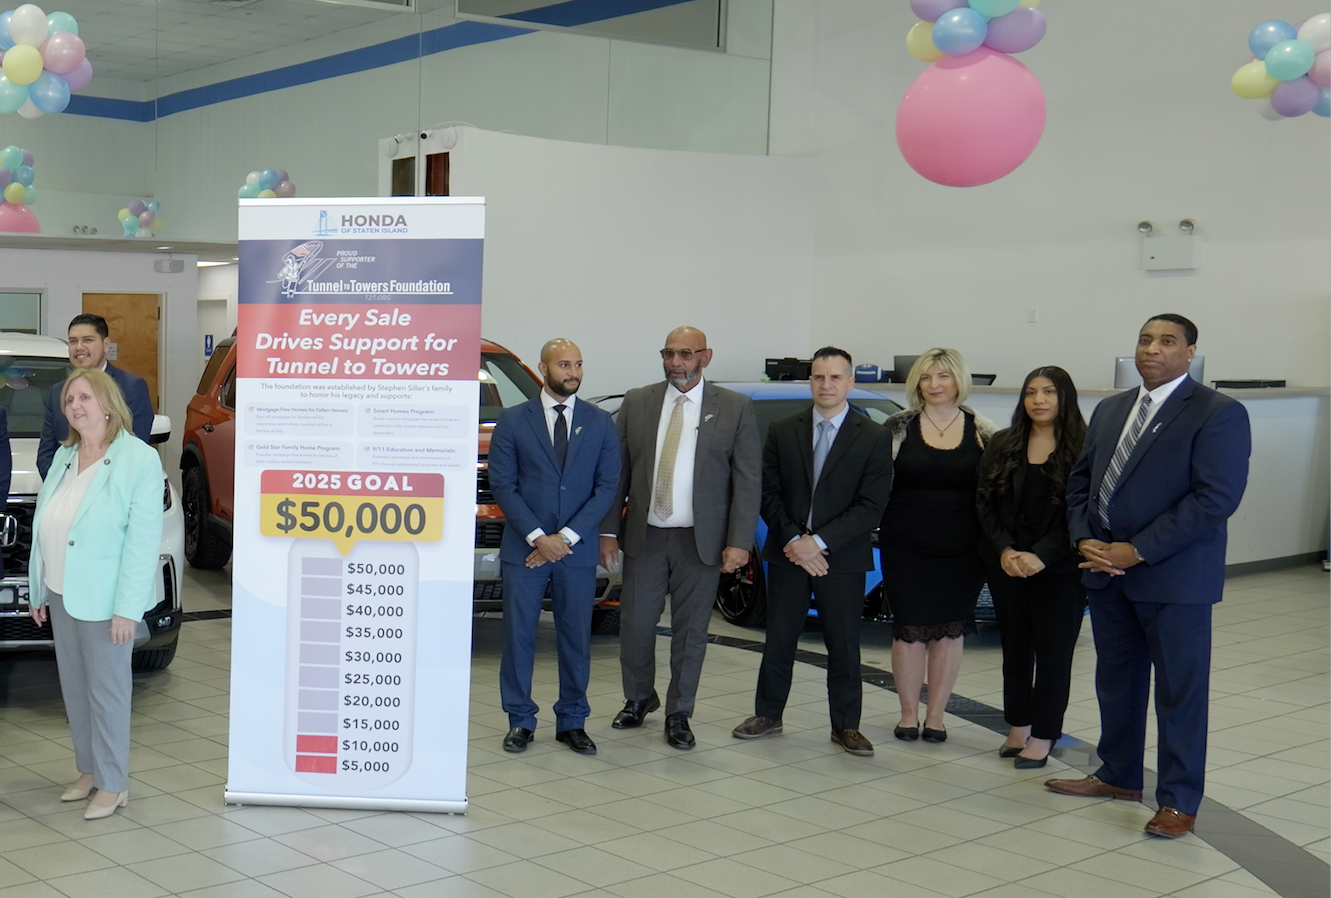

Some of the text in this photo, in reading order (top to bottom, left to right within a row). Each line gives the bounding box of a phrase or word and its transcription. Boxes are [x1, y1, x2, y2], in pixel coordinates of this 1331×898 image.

[342, 214, 408, 226] HONDA
[306, 280, 343, 292] Tunnel
[350, 280, 388, 292] Towers
[390, 280, 450, 292] Foundation
[299, 308, 411, 330] Every Sale
[256, 333, 458, 355] Drives Support for
[267, 357, 449, 376] Tunnel to Towers
[292, 473, 413, 491] 2025 GOAL
[276, 498, 426, 538] $50,000
[348, 562, 405, 576] $50,000
[346, 583, 404, 596] $45,000
[346, 604, 404, 618] $40,000
[346, 626, 403, 640] $35,000
[345, 651, 402, 664] $30,000
[344, 673, 401, 686] $25,000
[344, 695, 400, 708] $20,000
[343, 718, 400, 731] $15,000
[342, 740, 399, 752] $10,000
[342, 760, 390, 772] $5,000
